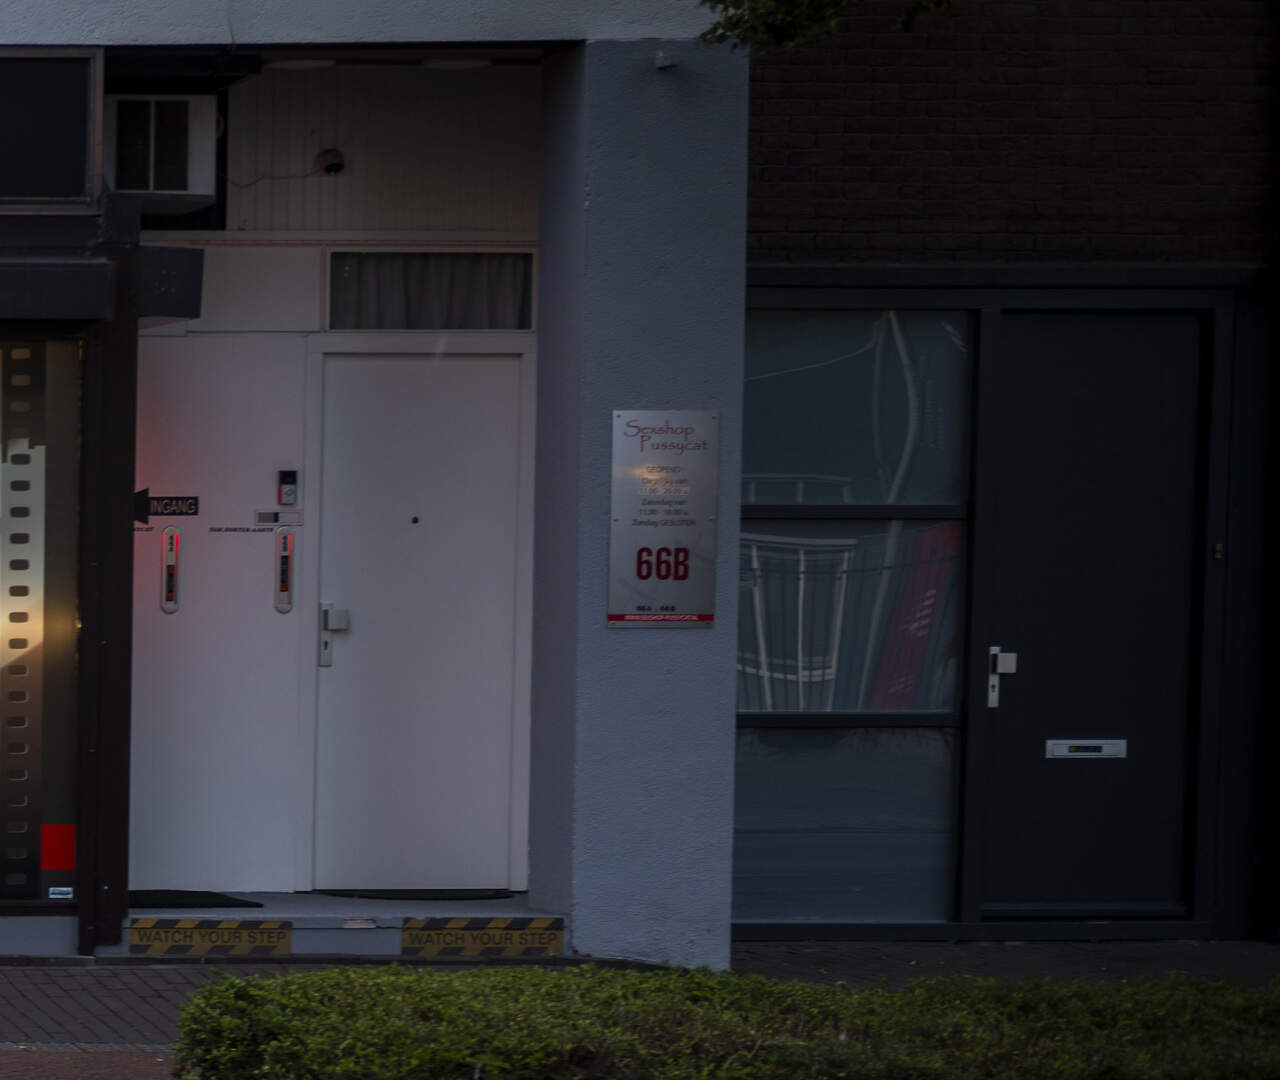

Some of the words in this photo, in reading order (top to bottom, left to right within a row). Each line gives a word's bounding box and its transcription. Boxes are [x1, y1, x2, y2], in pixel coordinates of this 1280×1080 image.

[150, 499, 196, 514] INGANG
[636, 547, 689, 581] 66B
[137, 929, 193, 946] WATCH
[198, 929, 242, 946] YOUR
[246, 929, 287, 946] STEP
[408, 930, 464, 947] WATCH
[468, 930, 516, 947] YOUR
[519, 930, 558, 947] STEP
